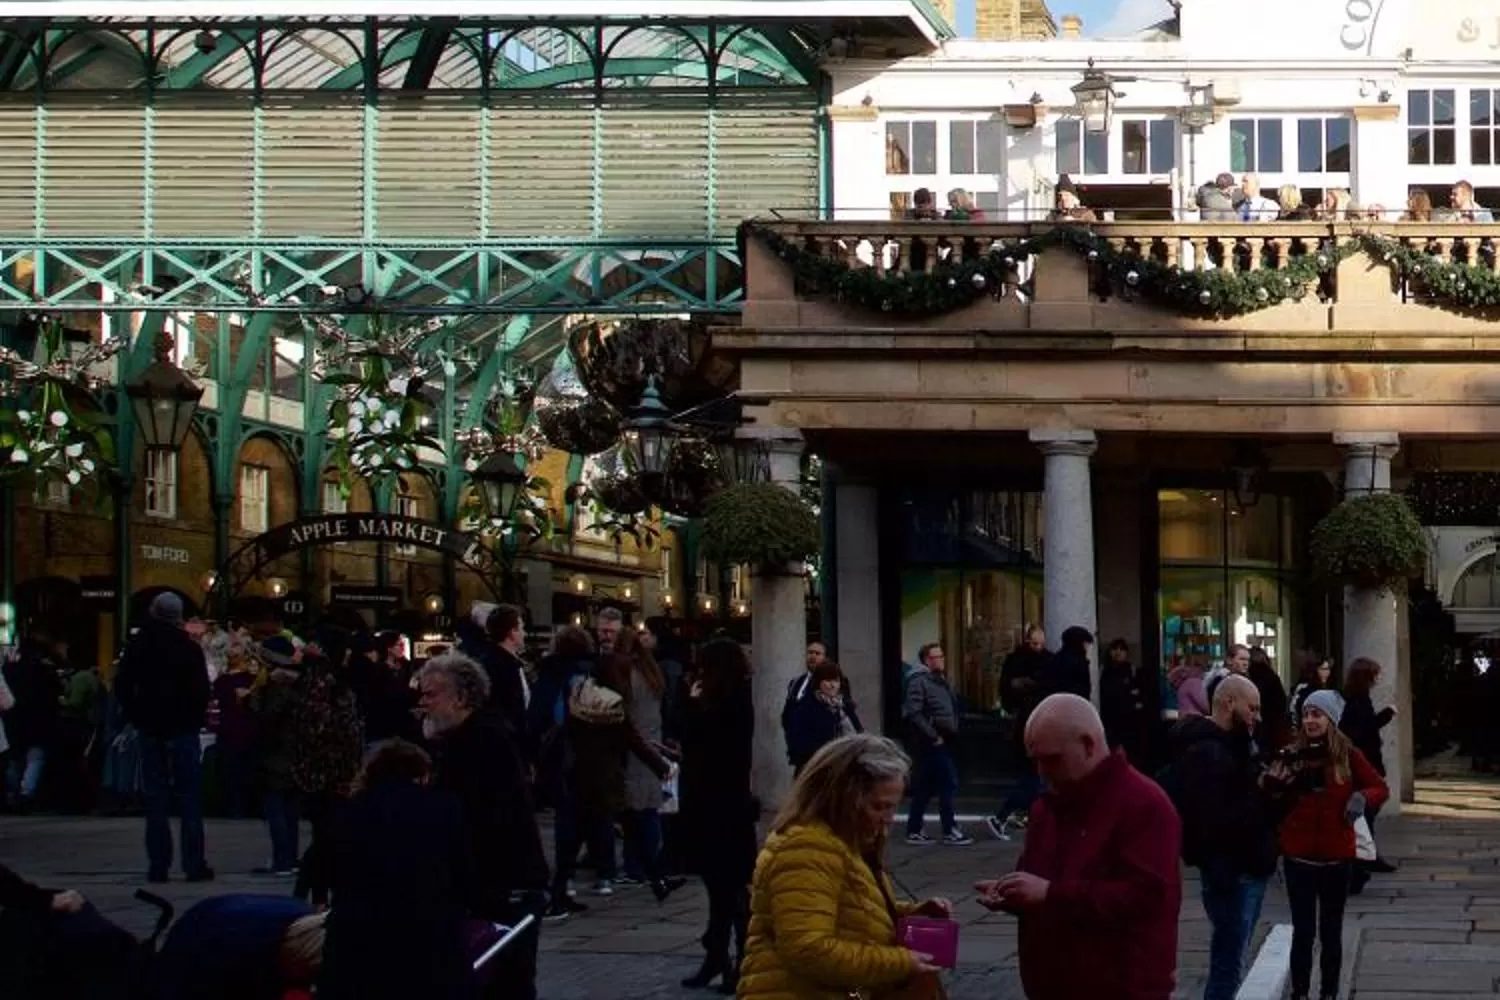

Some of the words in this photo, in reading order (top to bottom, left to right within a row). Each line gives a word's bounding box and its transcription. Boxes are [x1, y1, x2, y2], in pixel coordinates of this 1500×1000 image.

[1456, 17, 1480, 43] &
[289, 519, 350, 544] APPLE
[357, 519, 448, 546] MARKET
